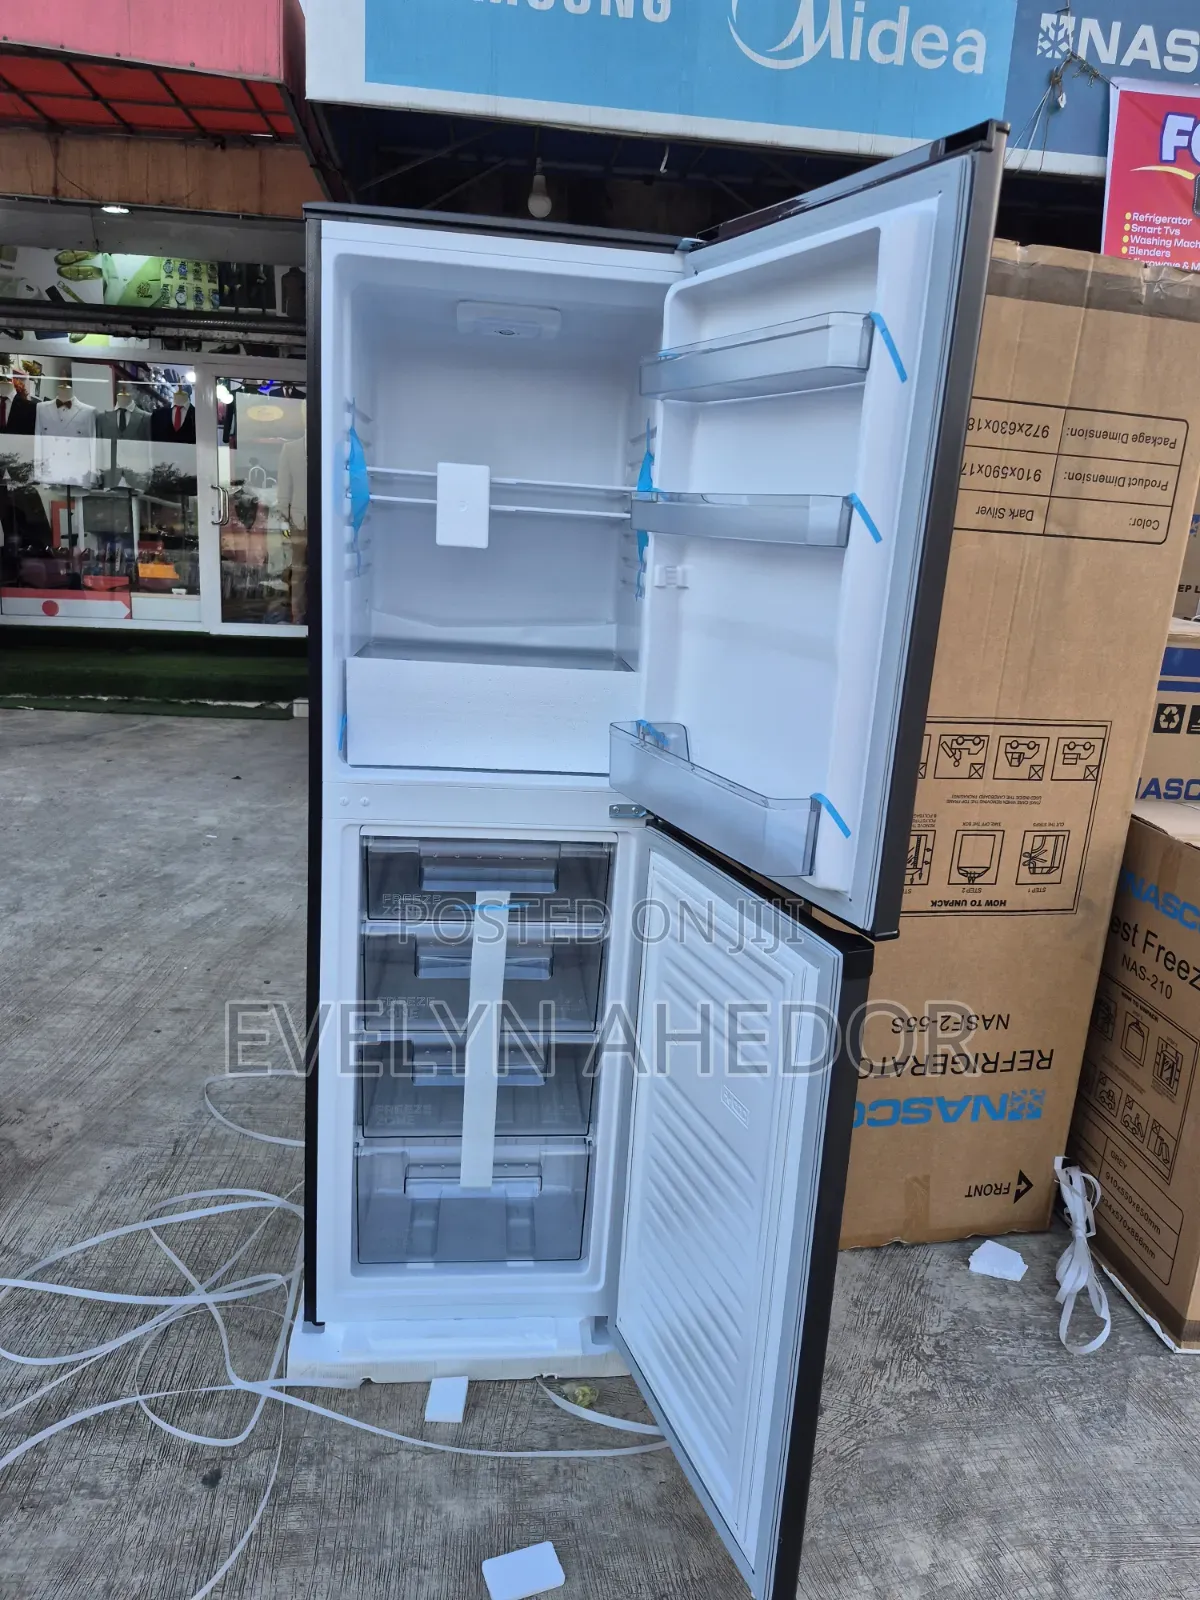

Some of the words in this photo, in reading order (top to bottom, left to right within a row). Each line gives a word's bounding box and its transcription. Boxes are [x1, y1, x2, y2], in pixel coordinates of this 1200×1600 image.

[727, 0, 987, 75] Midea
[1077, 15, 1200, 75] NAS
[1160, 111, 1200, 166] F
[1131, 212, 1193, 226] Refrigerator
[1131, 223, 1162, 234] Smart
[1163, 225, 1181, 236] Tvs
[1129, 234, 1172, 248] Washing
[1128, 246, 1171, 258] Blenders
[1066, 427, 1129, 444] Dimension:
[1132, 432, 1177, 450] Package
[1064, 471, 1125, 488] Dimension:
[1128, 477, 1169, 491] Product
[976, 505, 1006, 519] Silver
[1009, 508, 1034, 521] Dark
[1129, 517, 1160, 531] Color:
[985, 899, 1006, 907] HOW
[1122, 869, 1200, 933] NASC
[1121, 953, 1173, 1000] NAS-210
[890, 1013, 1010, 1034] NASF2-55S
[1110, 1149, 1128, 1170] GREY
[964, 1181, 1011, 1198] FRONT
